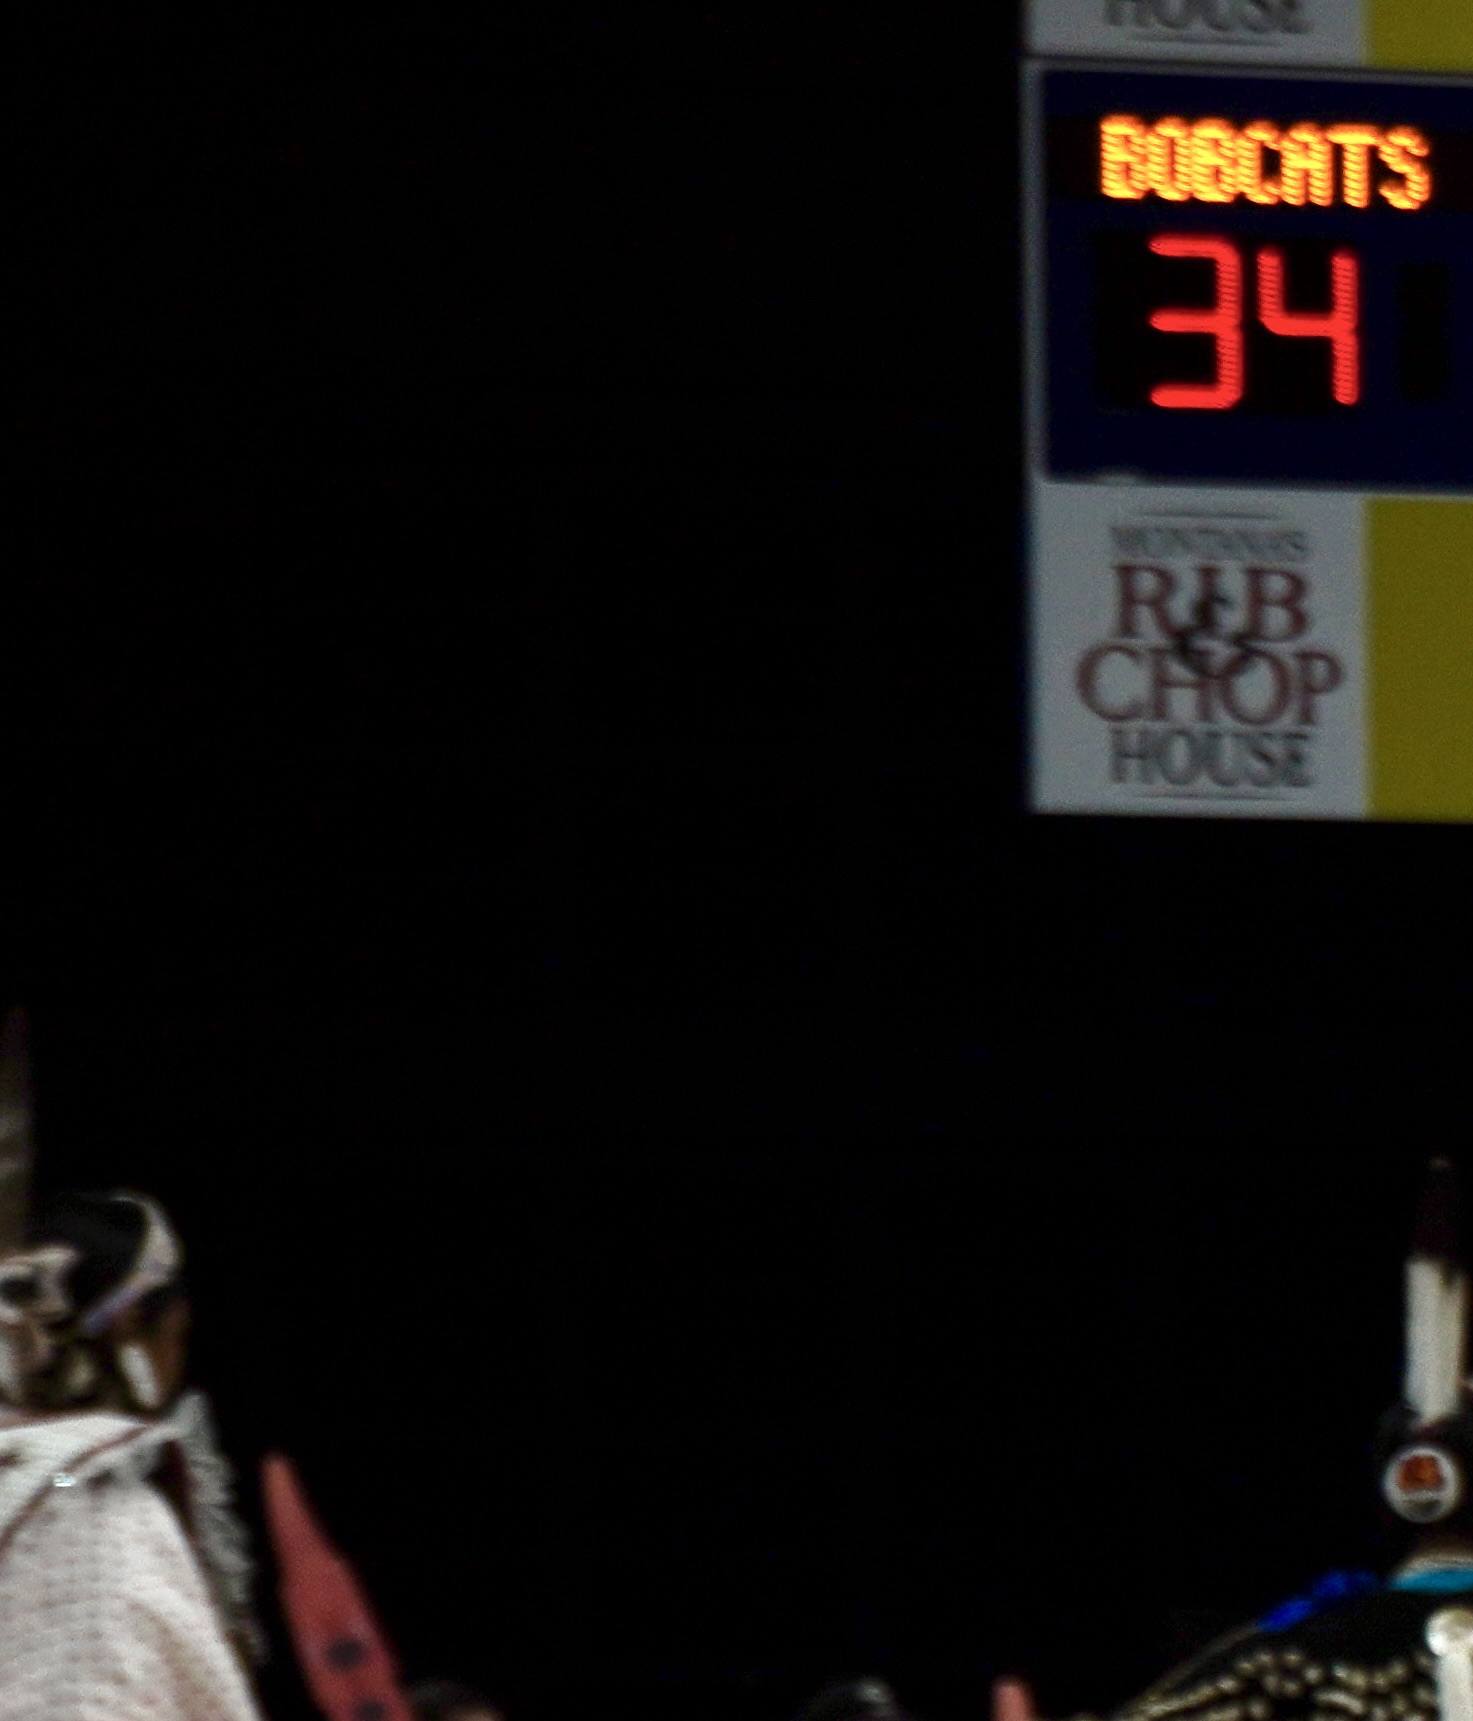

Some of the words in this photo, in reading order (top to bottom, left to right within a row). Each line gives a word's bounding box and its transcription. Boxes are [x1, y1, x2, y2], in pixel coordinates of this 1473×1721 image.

[1098, 114, 1431, 210] BOBCATS
[1148, 234, 1360, 410] 34
[1075, 644, 1345, 726] CHOP
[1109, 728, 1311, 788] HOUSE
